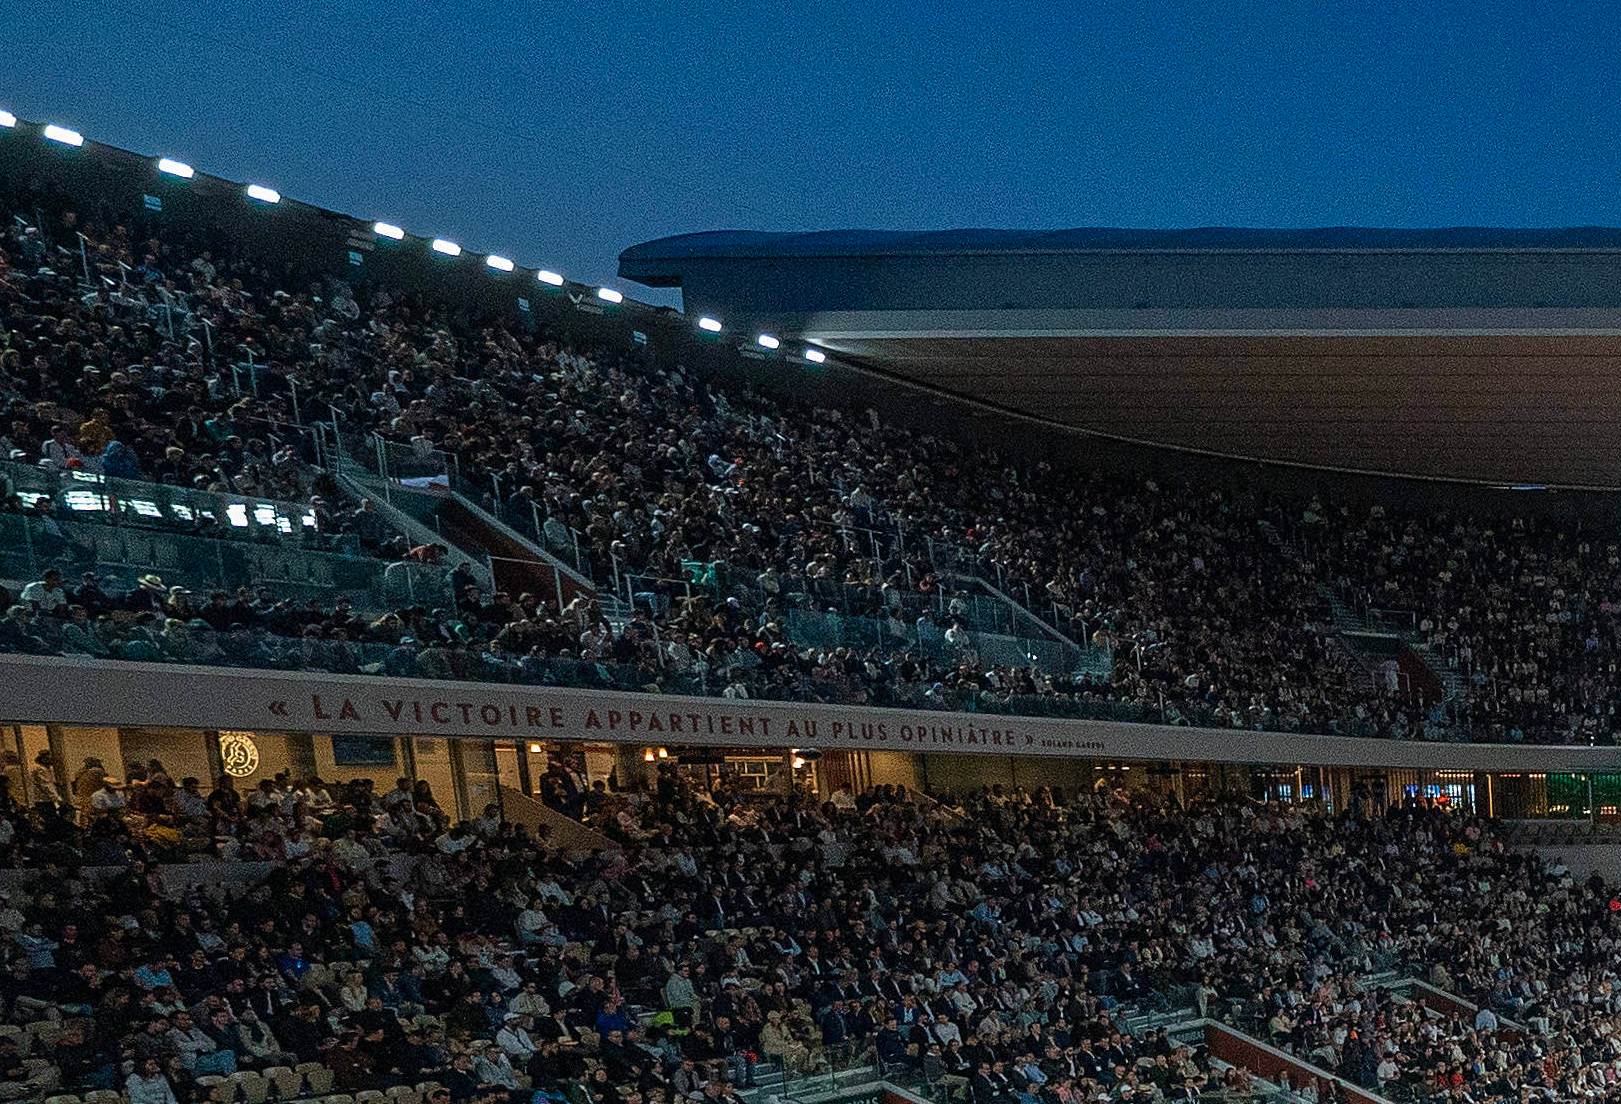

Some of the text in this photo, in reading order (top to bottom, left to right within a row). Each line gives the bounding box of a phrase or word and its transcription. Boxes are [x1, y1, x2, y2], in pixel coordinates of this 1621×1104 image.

[313, 695, 360, 721] LA
[382, 699, 564, 728] VICTOIRE
[585, 707, 770, 736] APPARTIENT
[785, 719, 817, 739] AU
[832, 721, 889, 742] PLUS
